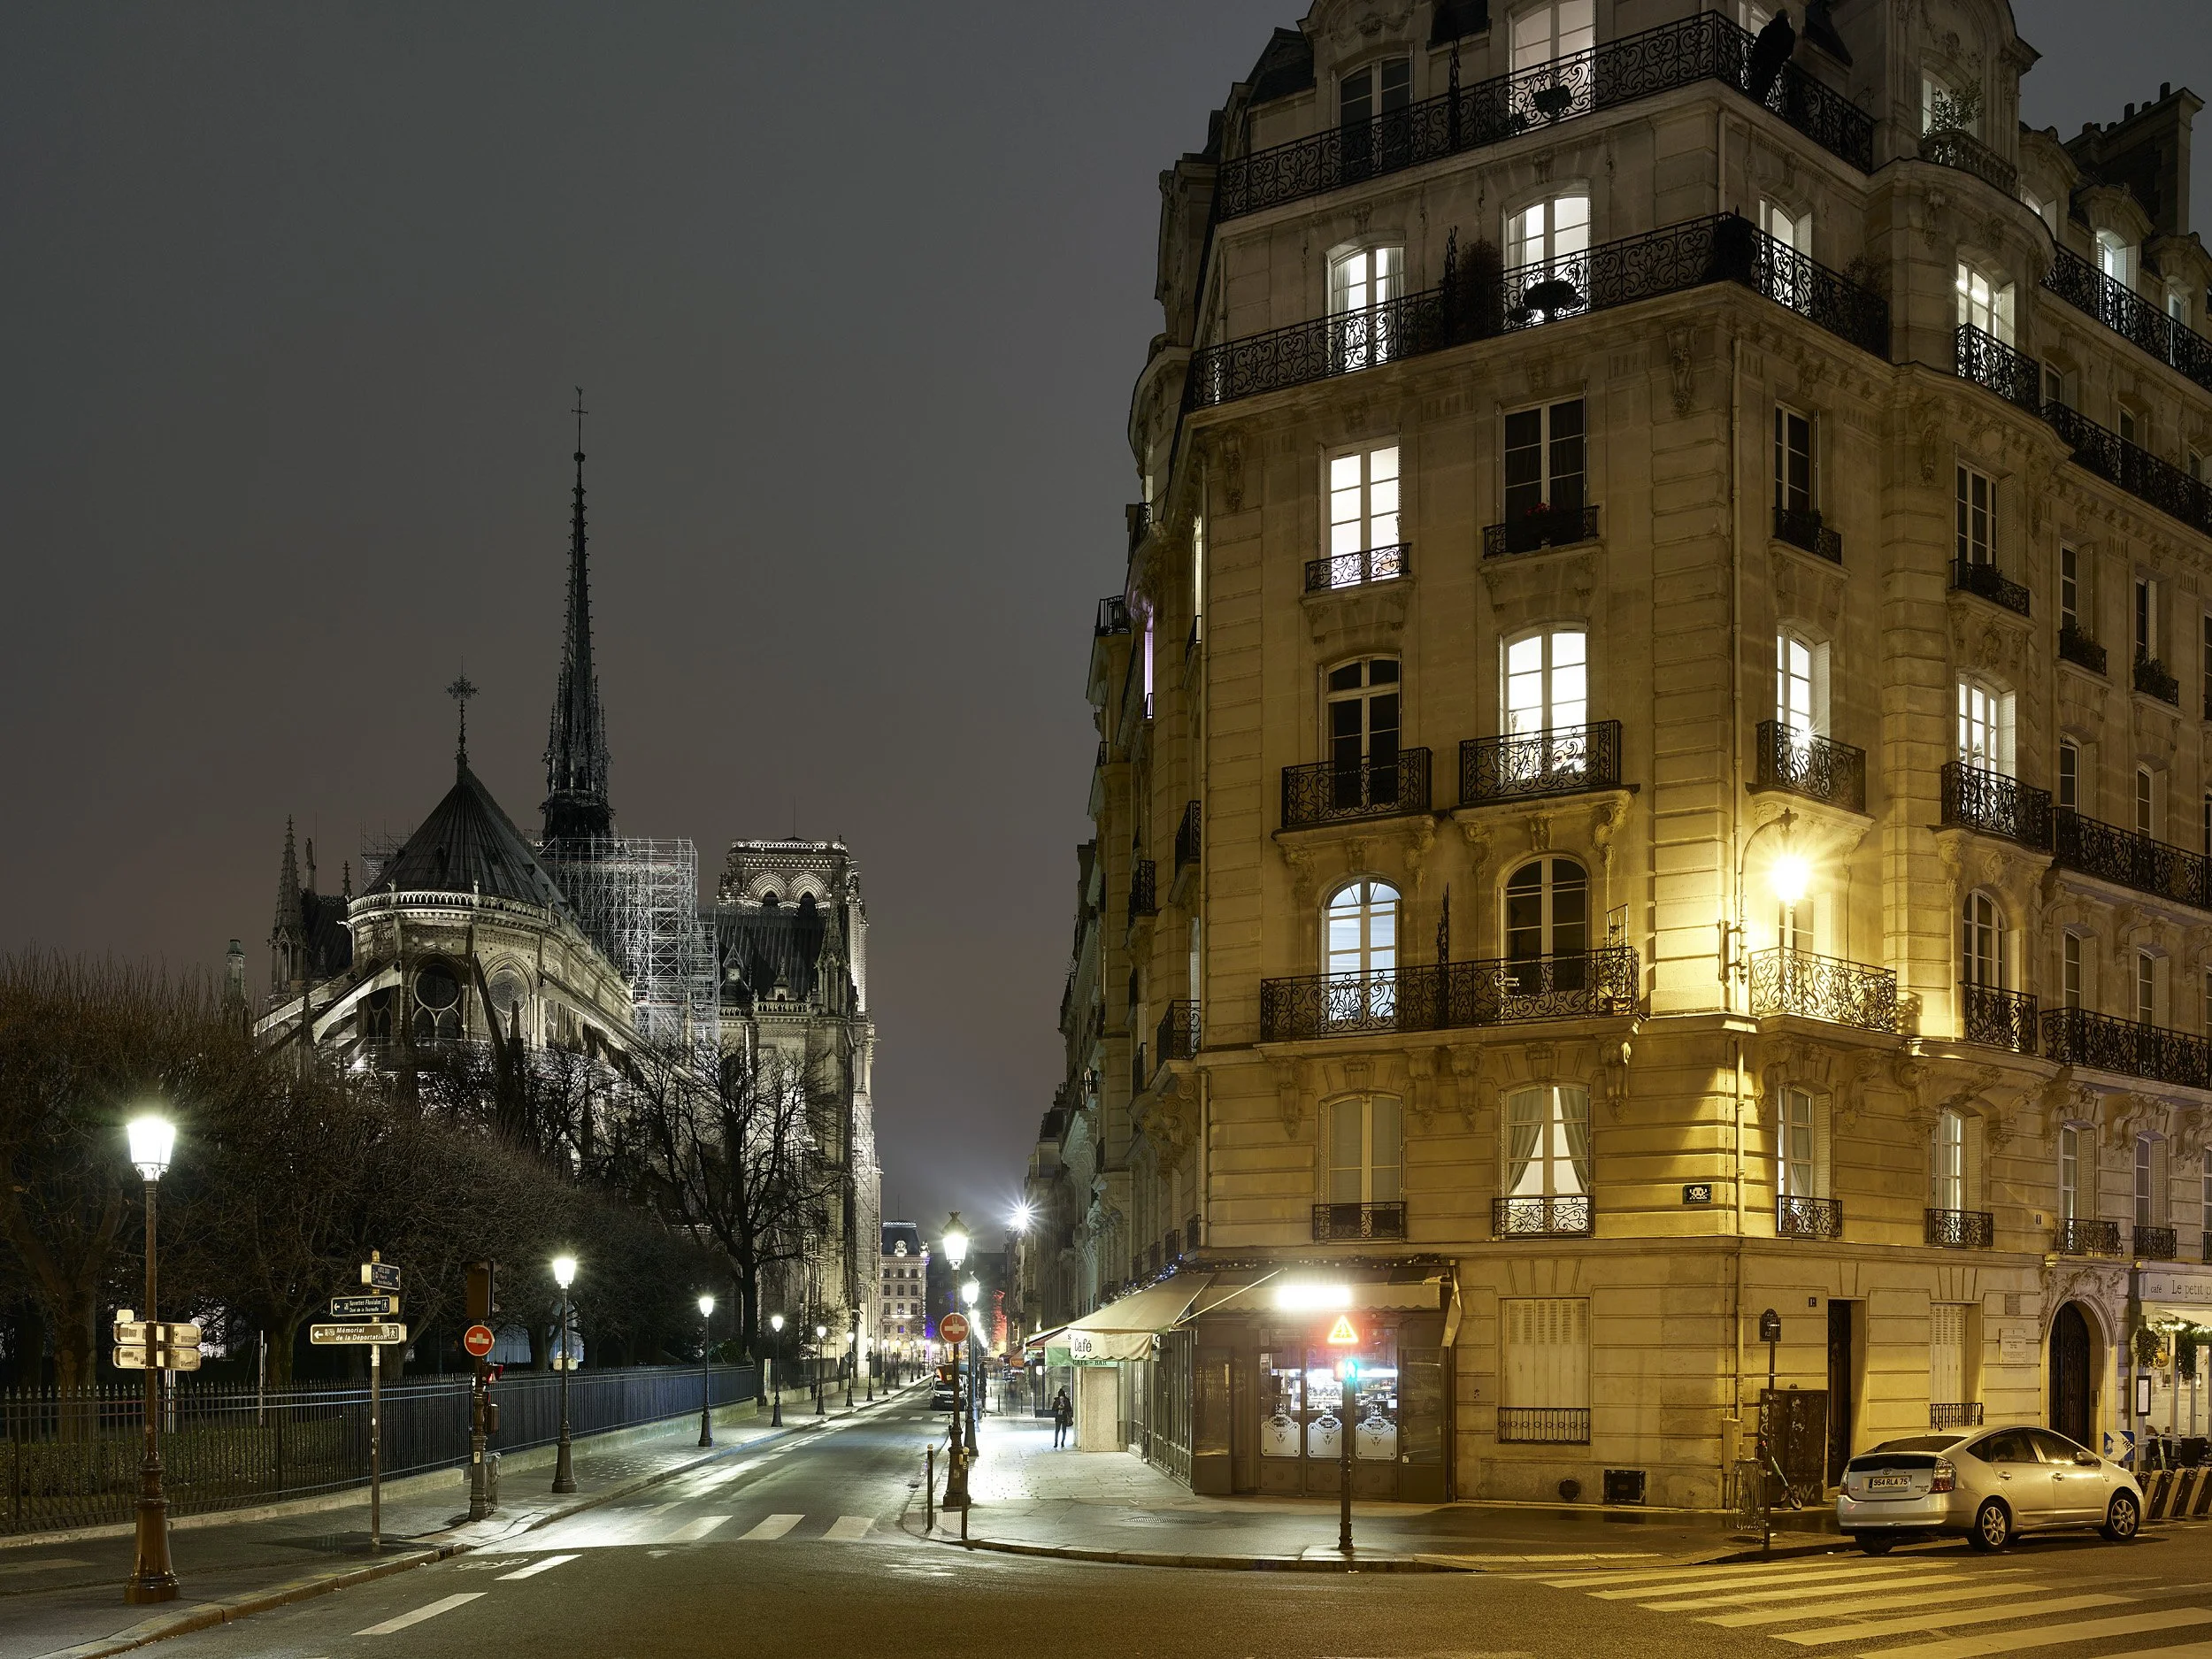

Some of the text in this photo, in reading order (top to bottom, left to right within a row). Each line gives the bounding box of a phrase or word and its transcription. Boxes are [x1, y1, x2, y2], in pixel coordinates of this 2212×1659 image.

[2150, 1285, 2162, 1294] café
[2171, 1279, 2182, 1294] Le
[2185, 1283, 2203, 1299] petit
[352, 1333, 388, 1342] Déportation
[1074, 1338, 1092, 1353] Café
